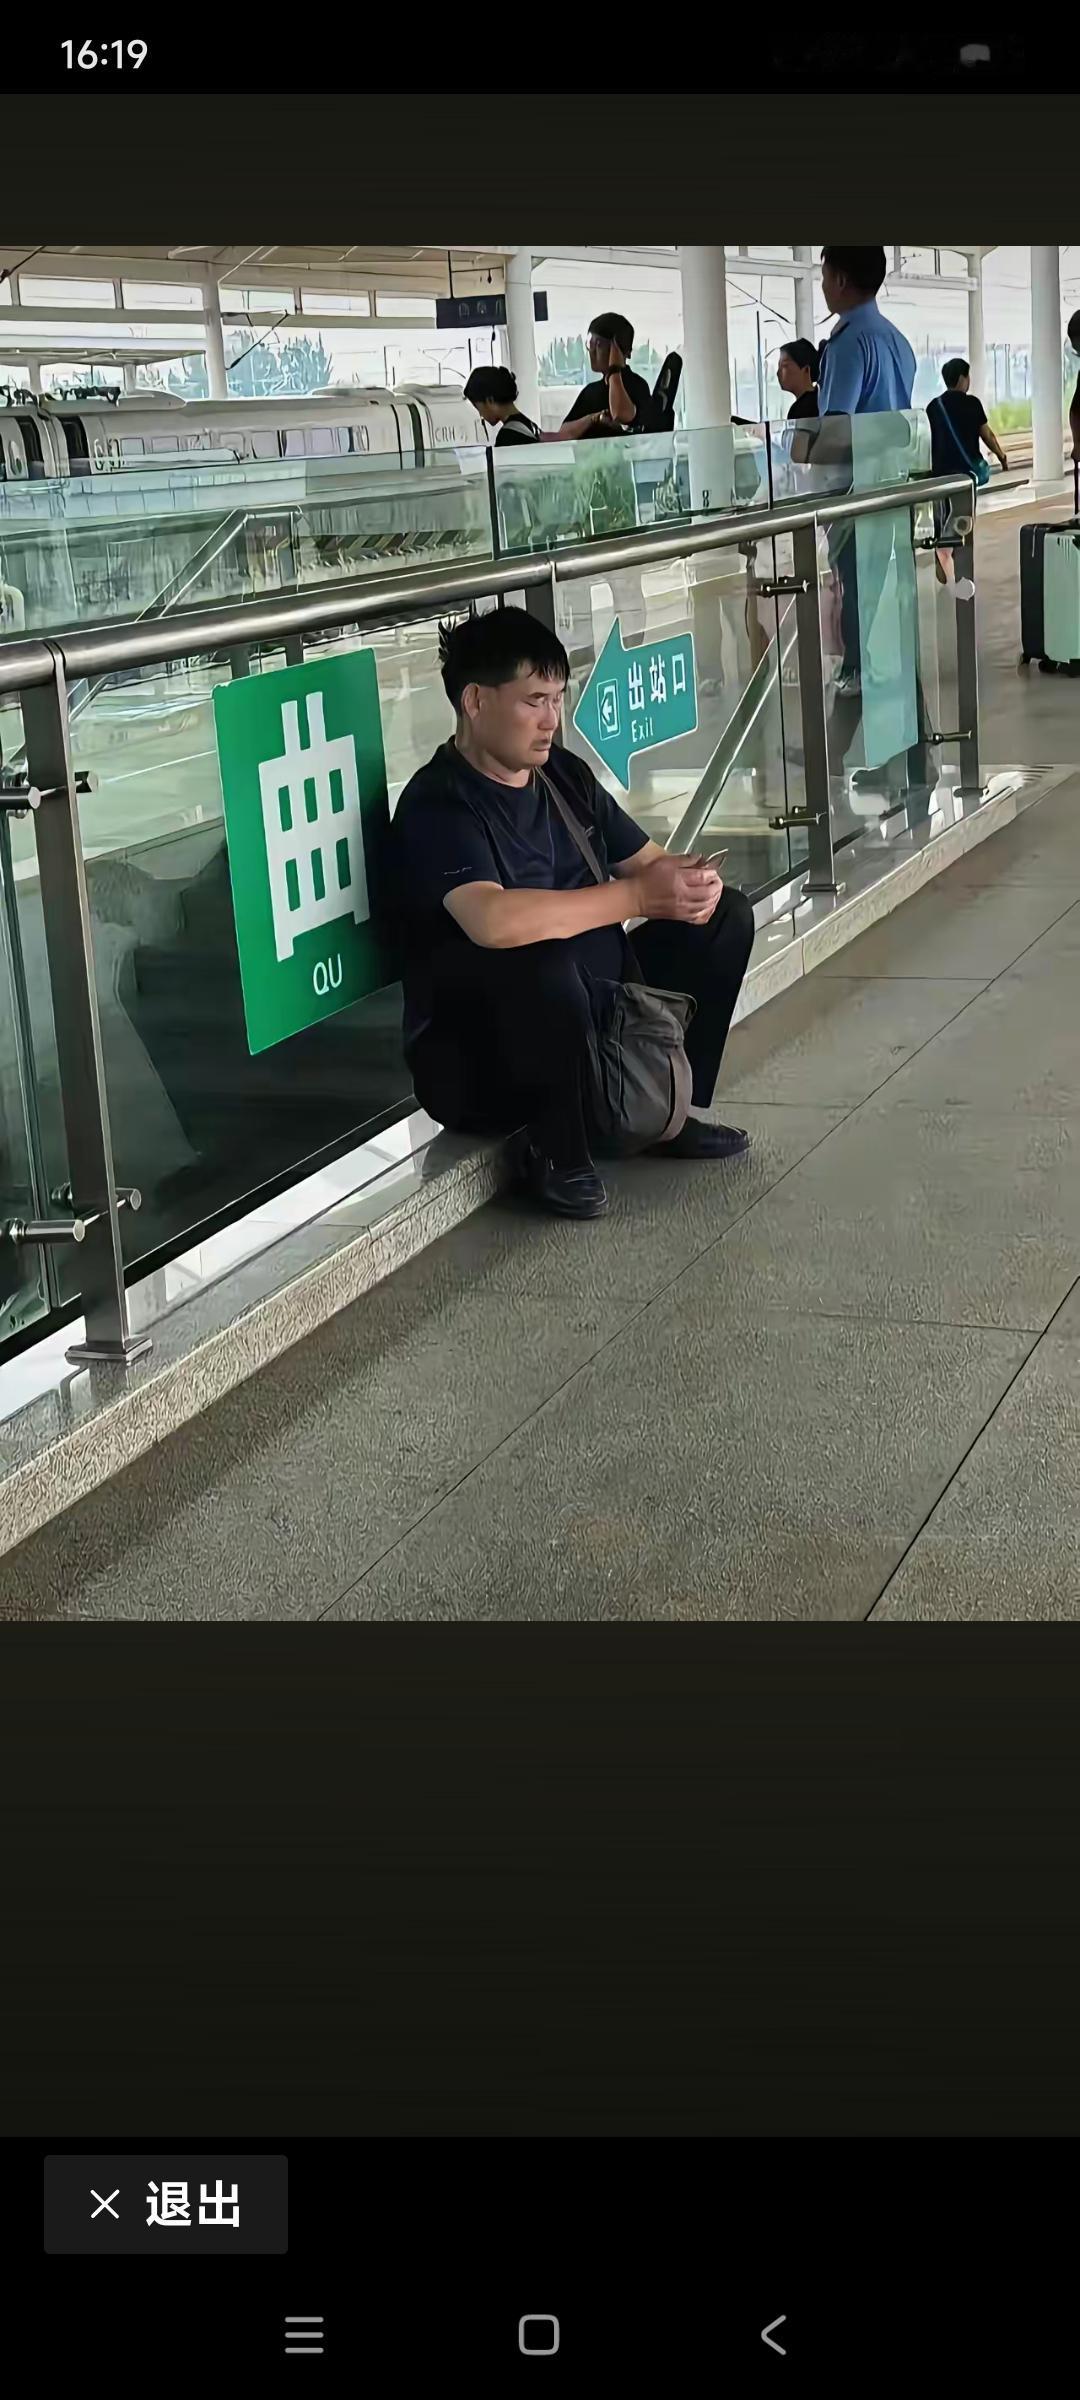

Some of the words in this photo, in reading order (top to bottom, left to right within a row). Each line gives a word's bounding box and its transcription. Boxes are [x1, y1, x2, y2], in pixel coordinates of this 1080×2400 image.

[627, 653, 687, 711] 出站口
[630, 716, 654, 743] Exit
[313, 953, 343, 996] QU
